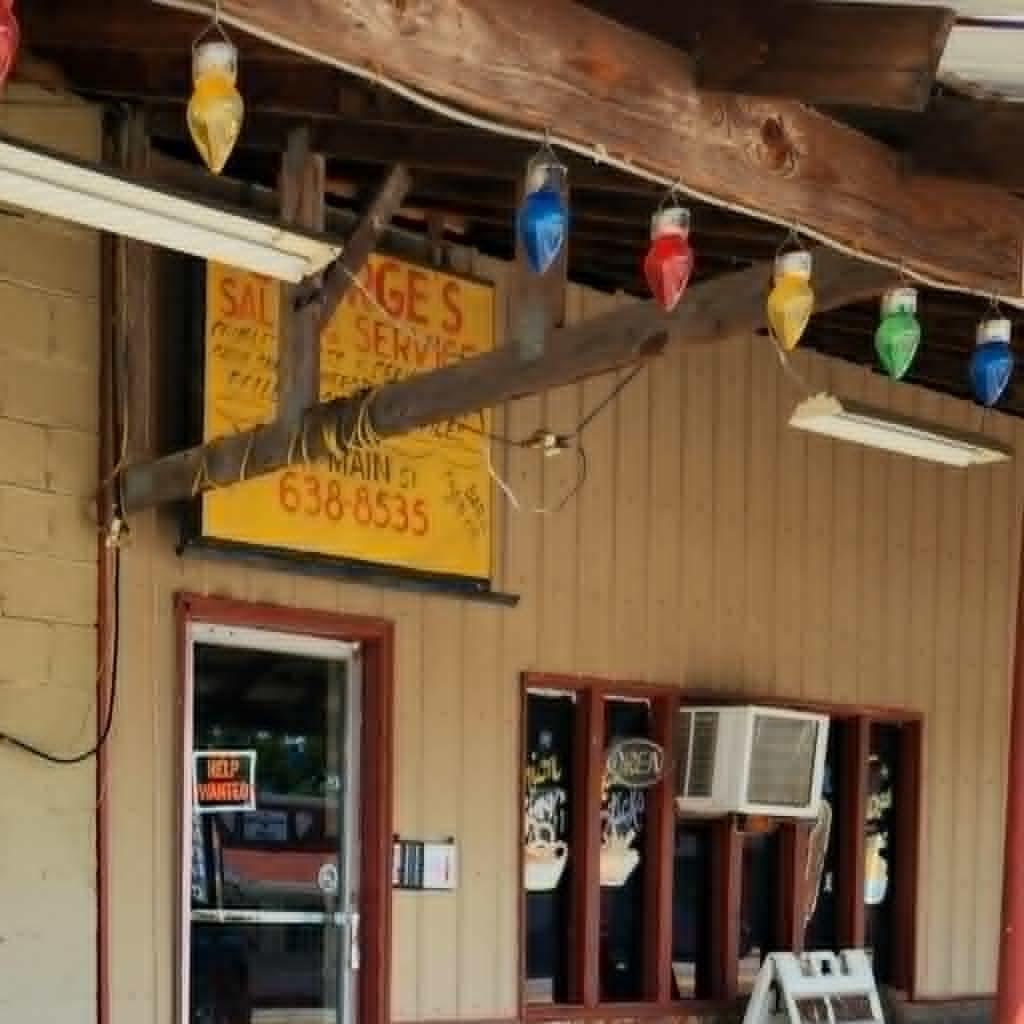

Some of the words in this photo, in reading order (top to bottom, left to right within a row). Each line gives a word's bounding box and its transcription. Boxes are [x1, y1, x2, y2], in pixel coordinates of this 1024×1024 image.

[221, 276, 275, 326] SAL
[327, 449, 391, 484] MAIN
[278, 471, 429, 537] 638-8535
[207, 758, 241, 778] HELP
[196, 782, 251, 801] WANTED
